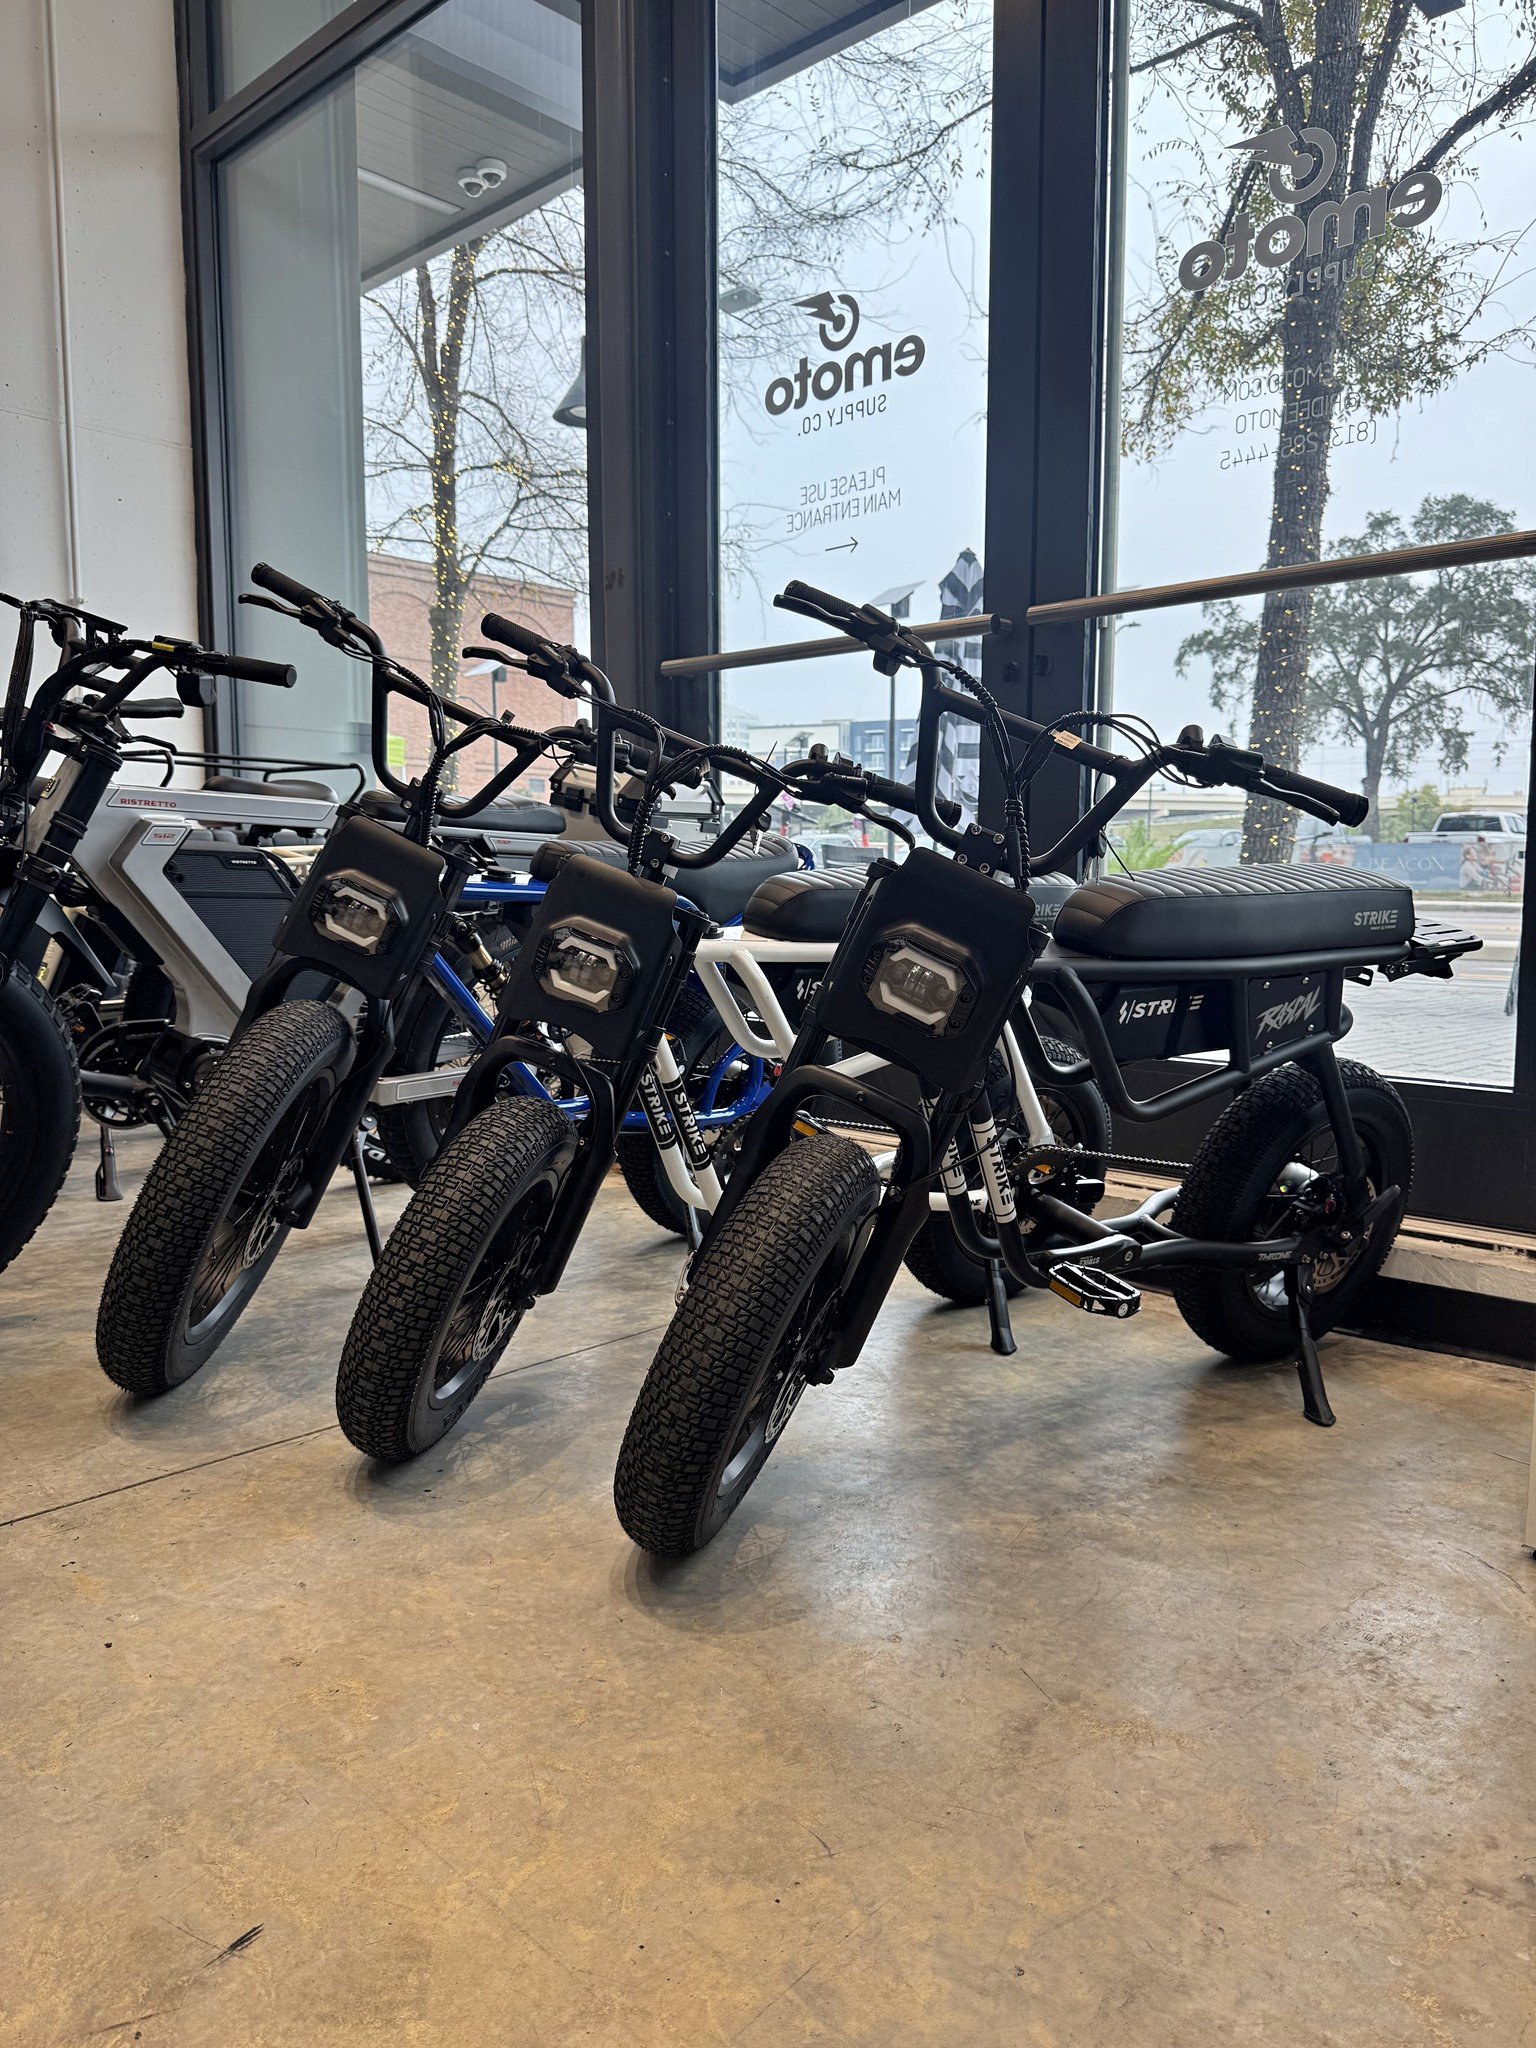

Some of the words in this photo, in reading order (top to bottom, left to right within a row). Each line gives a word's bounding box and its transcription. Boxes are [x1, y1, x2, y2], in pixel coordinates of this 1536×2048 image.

[120, 797, 177, 809] RISTRETTO
[1368, 856, 1445, 872] BEACON
[1353, 909, 1399, 926] STRIKE
[1132, 994, 1205, 1019] STRIE
[1255, 986, 1321, 1040] RASCAL
[641, 1073, 672, 1135] STRIKE
[674, 1091, 707, 1156] STRIKE
